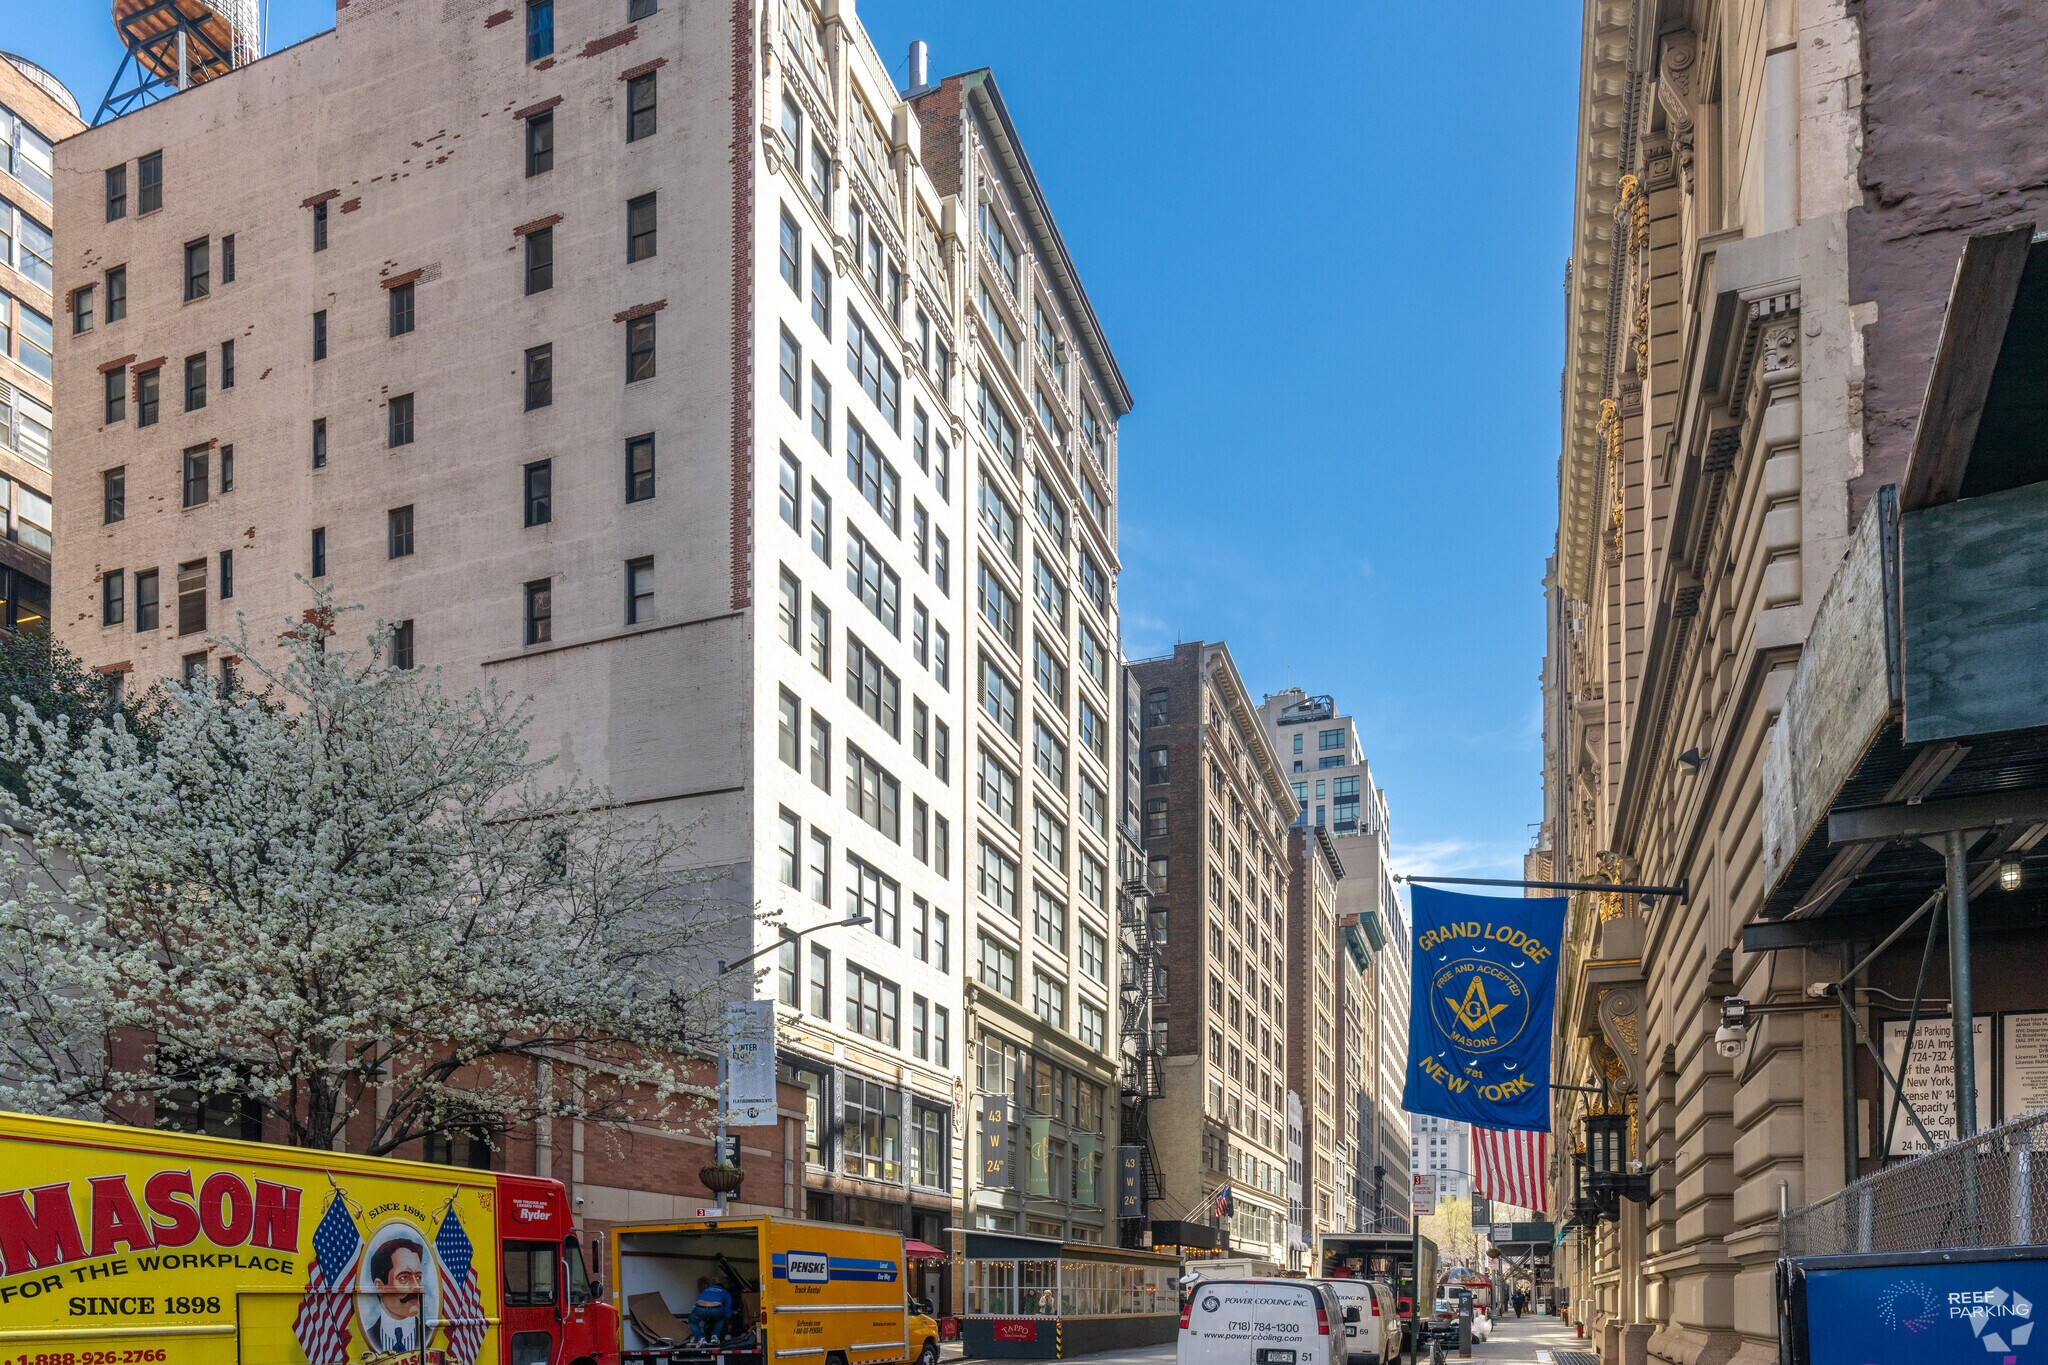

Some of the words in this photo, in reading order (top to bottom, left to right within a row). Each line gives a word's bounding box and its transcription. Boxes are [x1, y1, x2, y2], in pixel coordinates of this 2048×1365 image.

[1418, 921, 1481, 952] GRAND
[1484, 922, 1552, 965] LODGE
[1436, 970, 1454, 989] FREE
[1455, 963, 1474, 975] AND
[1476, 965, 1521, 997] ACCEPTED
[1465, 1000, 1481, 1018] G
[1924, 1025, 1951, 1037] Parking
[1450, 1030, 1498, 1048] MASONS
[1912, 1051, 1947, 1062] 724-732
[1464, 1066, 1483, 1079] 781
[1915, 1064, 1930, 1074] the
[1418, 1055, 1470, 1094] NEW
[1473, 1073, 1535, 1102] YORK
[1907, 1077, 1928, 1087] New
[1930, 1075, 1954, 1087] York,
[1902, 1090, 1929, 1101] icense
[1911, 1103, 1949, 1114] Capacity
[988, 1110, 1001, 1123] 43
[990, 1135, 1000, 1147] W
[1928, 1130, 1950, 1140] OPEN
[1902, 1141, 1912, 1151] 24
[1125, 1158, 1136, 1168] 43
[1126, 1177, 1134, 1187] W
[1415, 1176, 1420, 1185] 3
[368, 1202, 400, 1219] SINCE
[403, 1204, 426, 1222] 1898
[520, 1208, 551, 1222] Ryder
[0, 1168, 303, 1277] MASON
[790, 1261, 826, 1274] PENSKE
[0, 1274, 64, 1304] FOR
[70, 1259, 129, 1284] THE
[137, 1253, 295, 1275] WORKPLACE
[794, 1286, 807, 1294] Truck
[807, 1286, 822, 1295] Rental
[1254, 1297, 1291, 1306] COOLING
[1293, 1299, 1309, 1308] INC.
[1948, 1290, 1995, 1305] REEF
[69, 1296, 155, 1316] SINCE
[164, 1296, 221, 1315] 1898
[1949, 1303, 2030, 1319] PARKING
[1001, 1324, 1029, 1335] TAPPO
[1228, 1321, 1251, 1332] (718)
[1253, 1321, 1300, 1333] 784-1300
[1204, 1331, 1303, 1343] www.powercooling.com
[16, 1349, 167, 1365] 1-888-926-2766
[1301, 1352, 1312, 1362] 51
